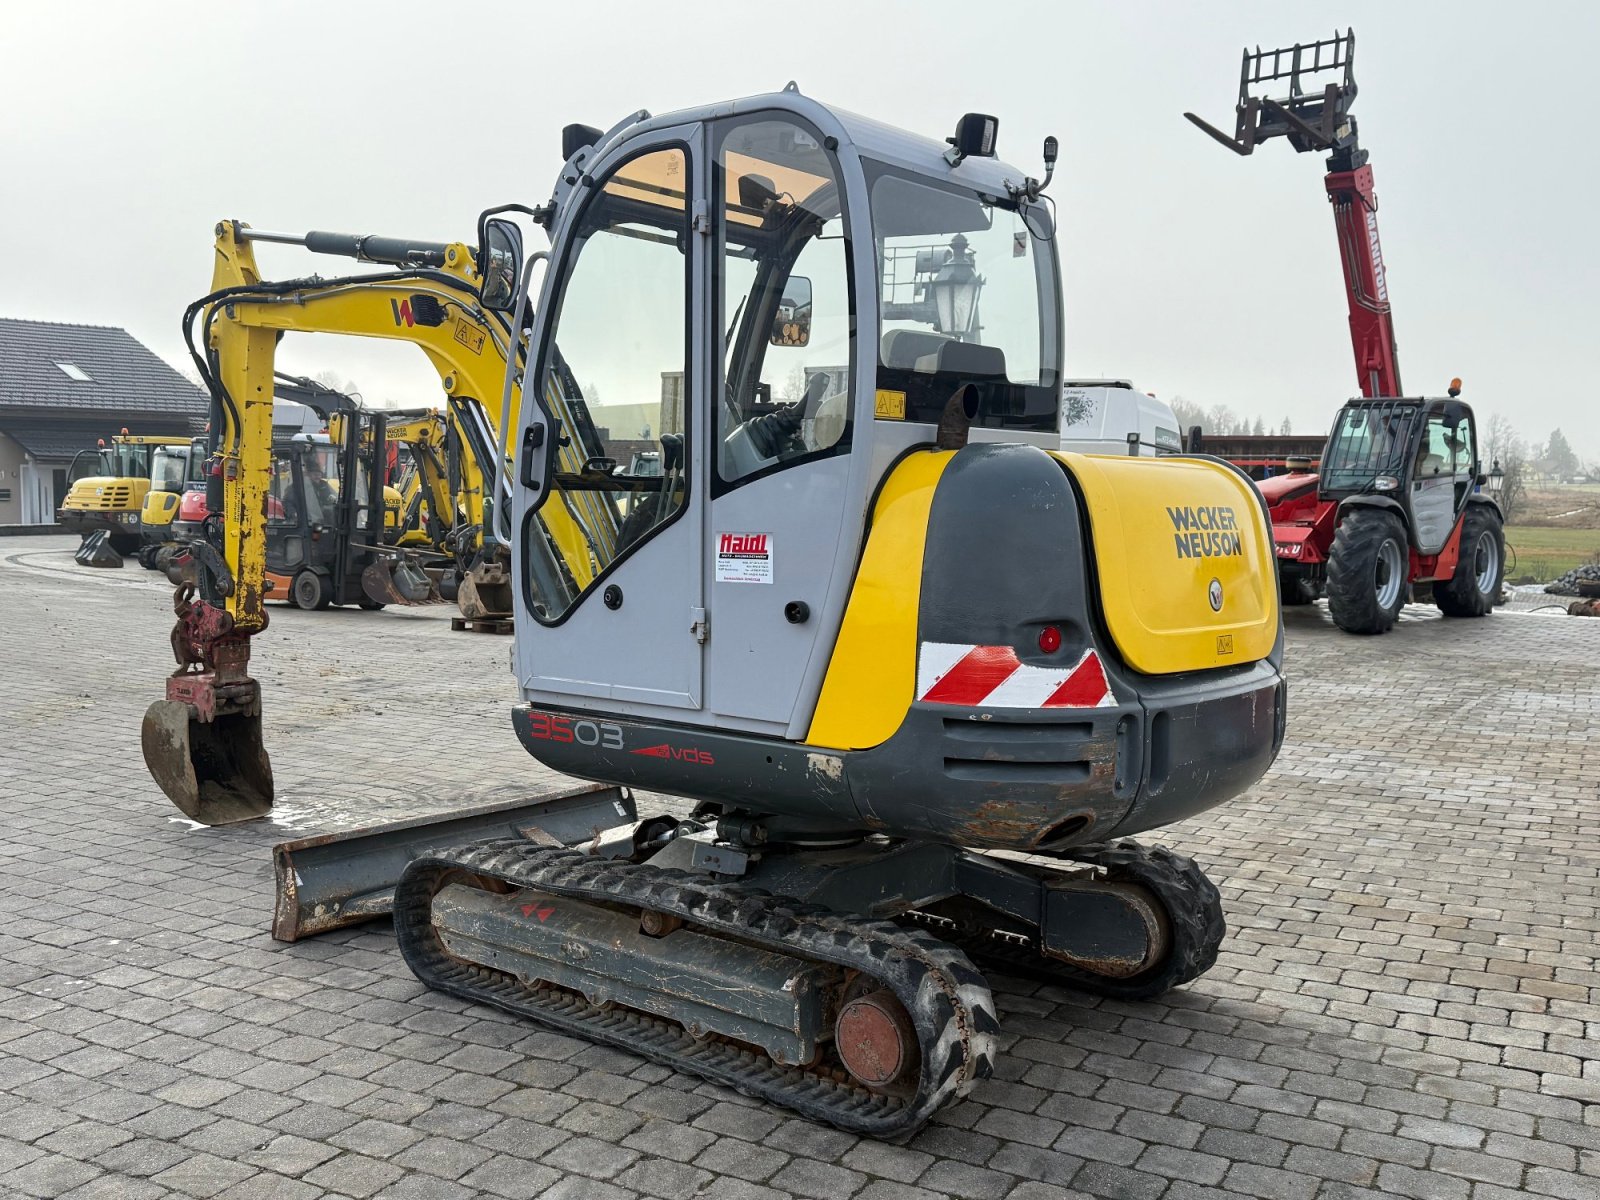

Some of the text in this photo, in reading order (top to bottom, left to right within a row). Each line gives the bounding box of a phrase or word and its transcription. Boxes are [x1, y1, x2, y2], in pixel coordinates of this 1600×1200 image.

[1366, 211, 1387, 301] MANITOU
[1165, 506, 1238, 532] WACKER
[1174, 532, 1242, 559] NEUSON
[528, 712, 625, 750] 3503
[670, 746, 715, 765] vds
